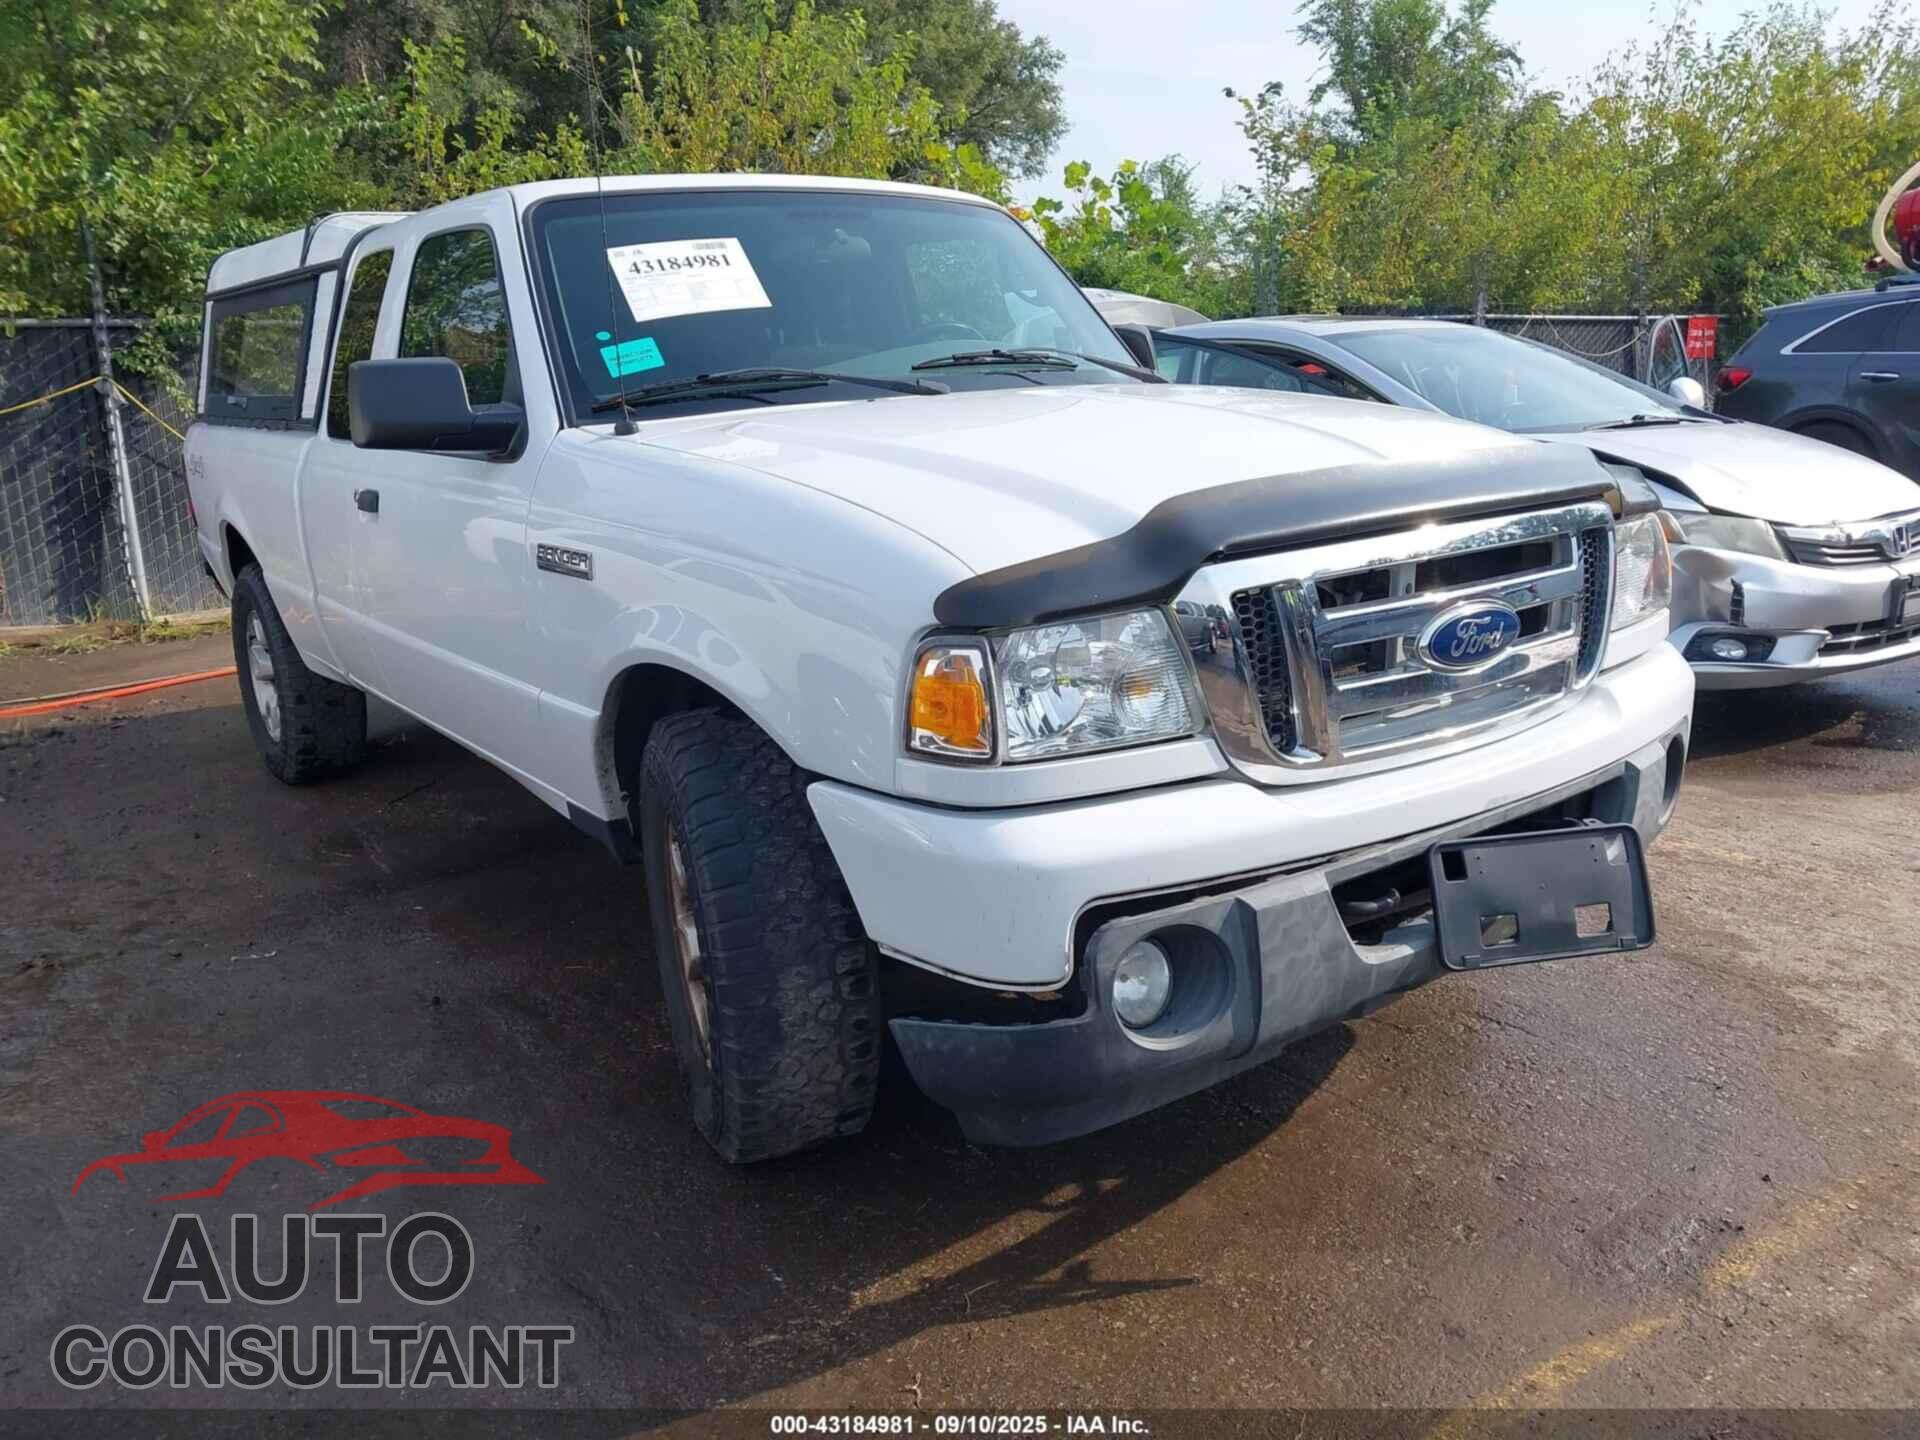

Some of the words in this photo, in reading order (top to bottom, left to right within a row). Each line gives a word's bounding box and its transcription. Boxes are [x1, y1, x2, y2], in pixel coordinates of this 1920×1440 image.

[628, 253, 732, 275] 43184981
[537, 544, 589, 569] RANGER
[1450, 616, 1505, 657] Ford
